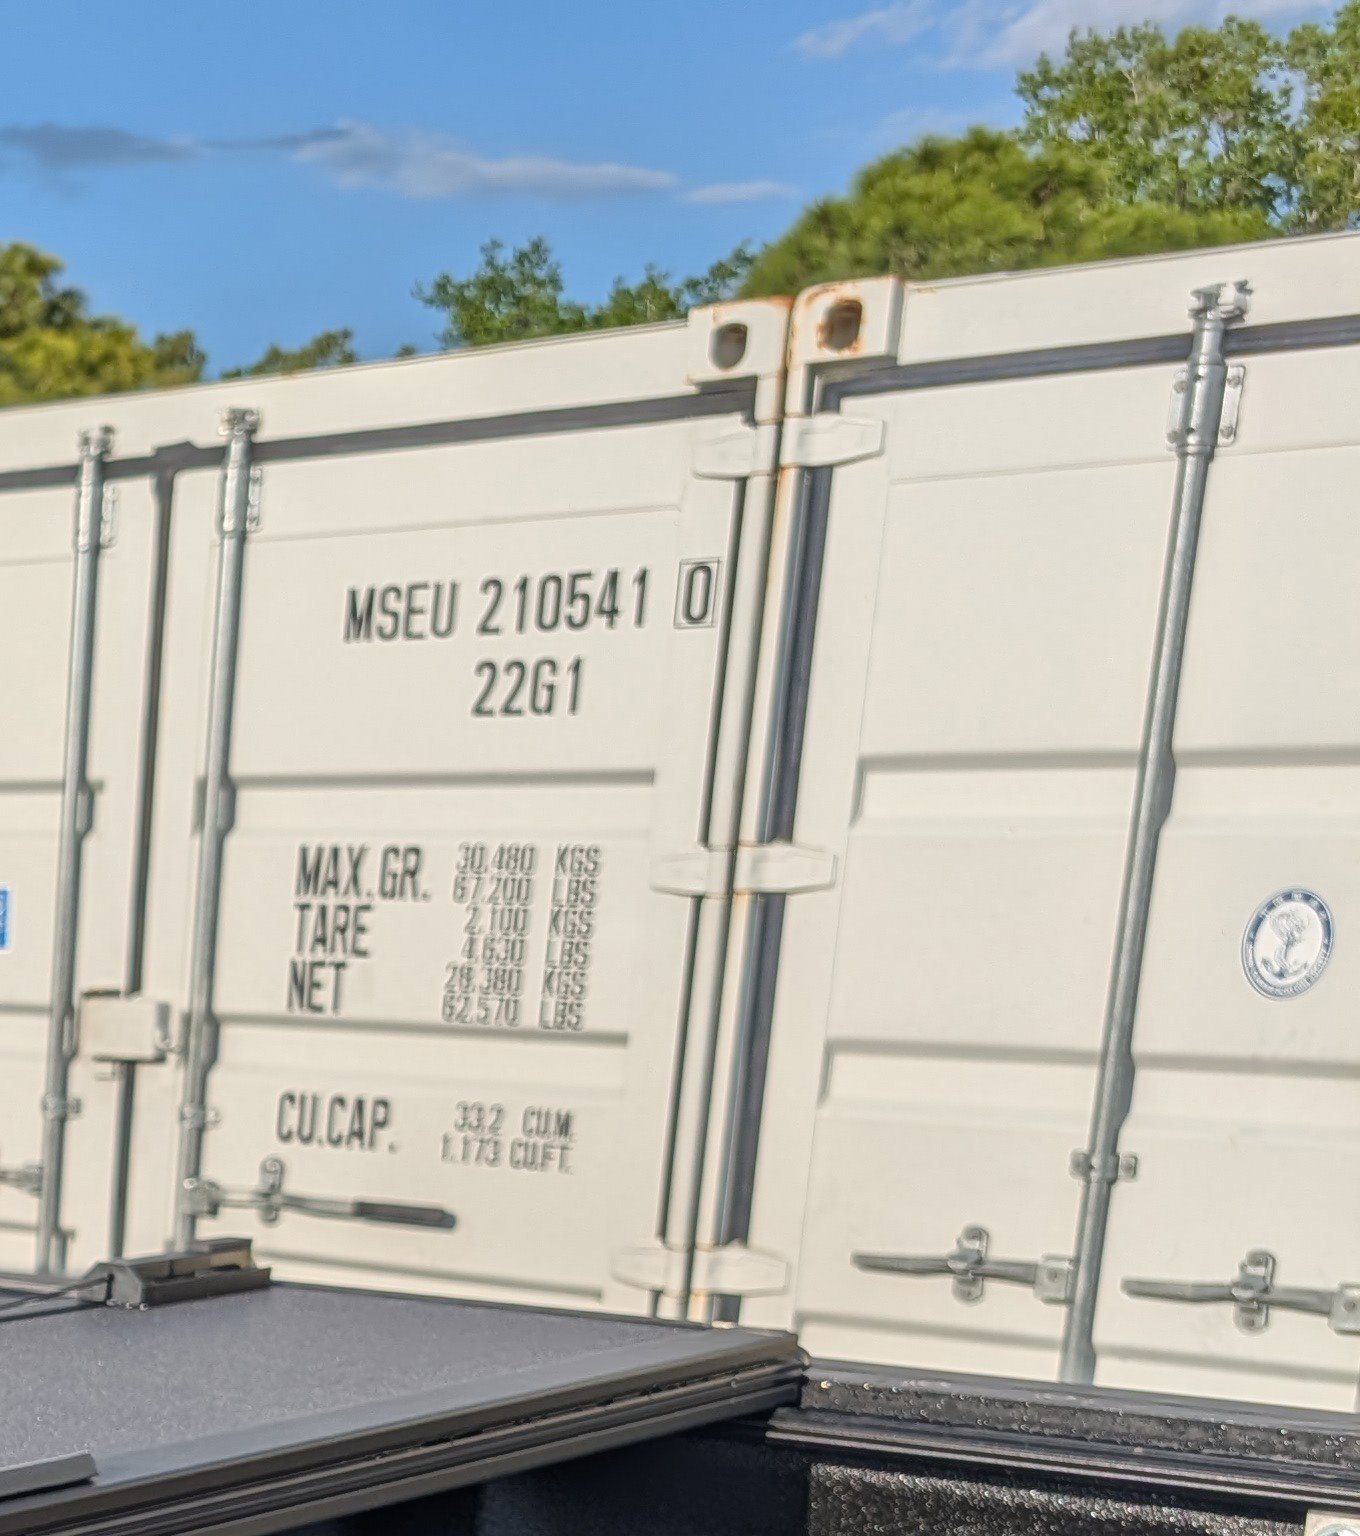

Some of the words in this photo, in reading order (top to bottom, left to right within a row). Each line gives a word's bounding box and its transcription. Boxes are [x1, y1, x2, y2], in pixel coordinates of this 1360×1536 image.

[344, 581, 458, 642] MSEU
[477, 567, 648, 635] 210541
[681, 564, 712, 625] 0
[471, 655, 582, 717] 22G1
[555, 843, 602, 877] KGS
[551, 877, 599, 909] LBS
[295, 902, 372, 957] TARE
[548, 907, 595, 940] KGS
[545, 939, 591, 970] LBS
[287, 959, 347, 1015] NET
[543, 969, 588, 1001] KGS
[539, 999, 584, 1031] LBS
